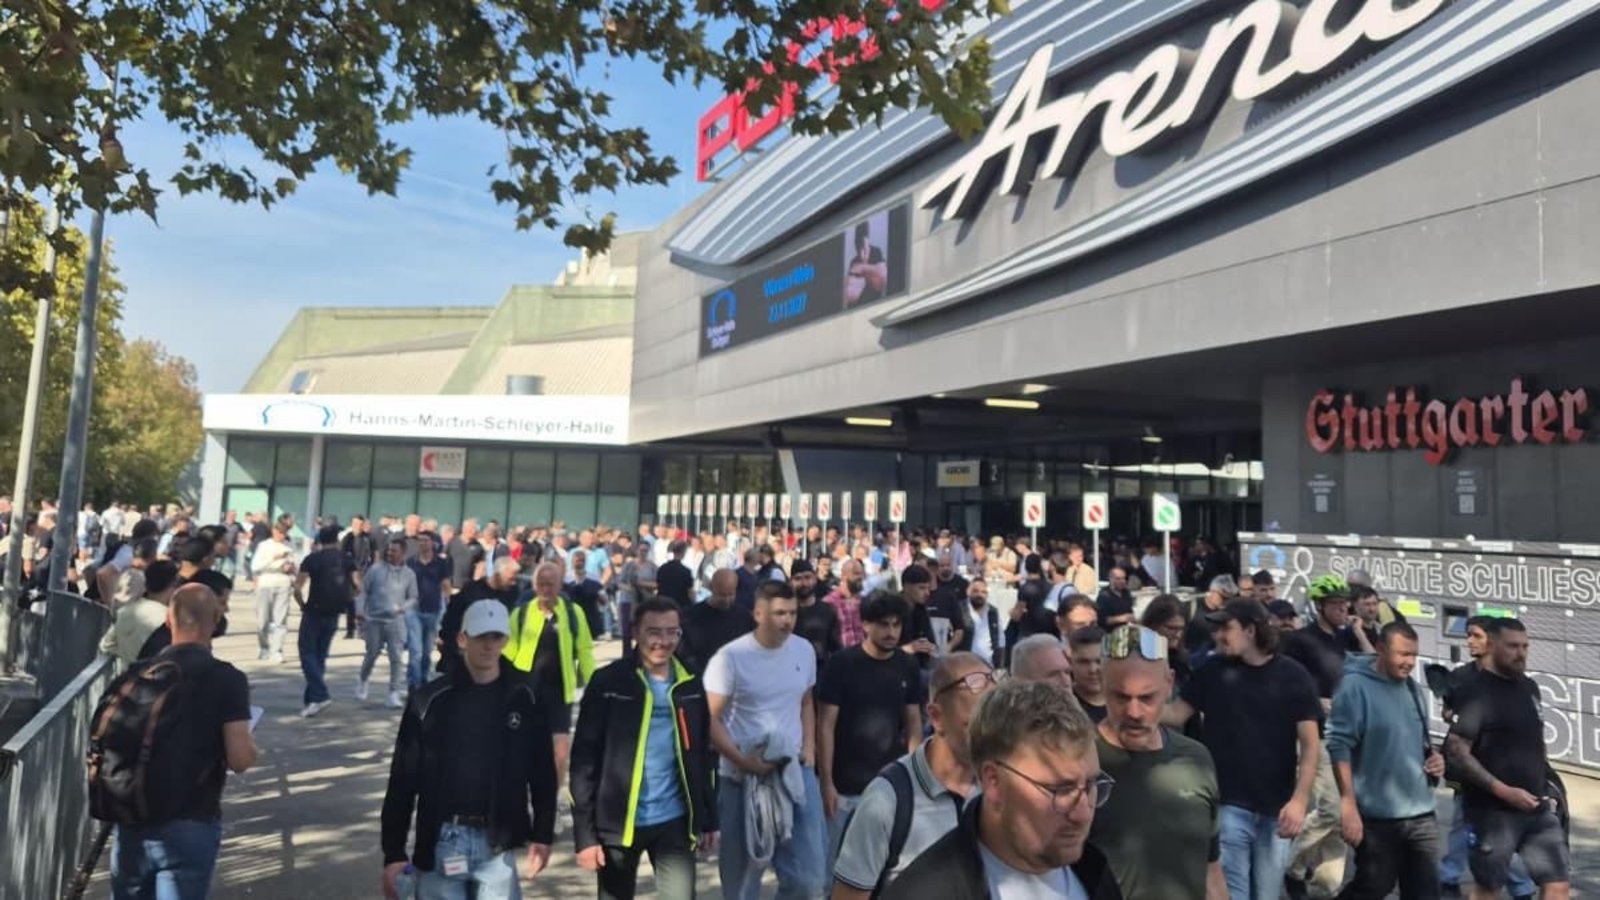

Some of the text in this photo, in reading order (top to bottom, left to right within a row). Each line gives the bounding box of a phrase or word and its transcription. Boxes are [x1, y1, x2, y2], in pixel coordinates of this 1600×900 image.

[349, 411, 614, 435] Hanns-Martin-Schleyer-Halle
[1305, 376, 1588, 465] Stuttgarter
[1450, 561, 1600, 606] SCHLIES
